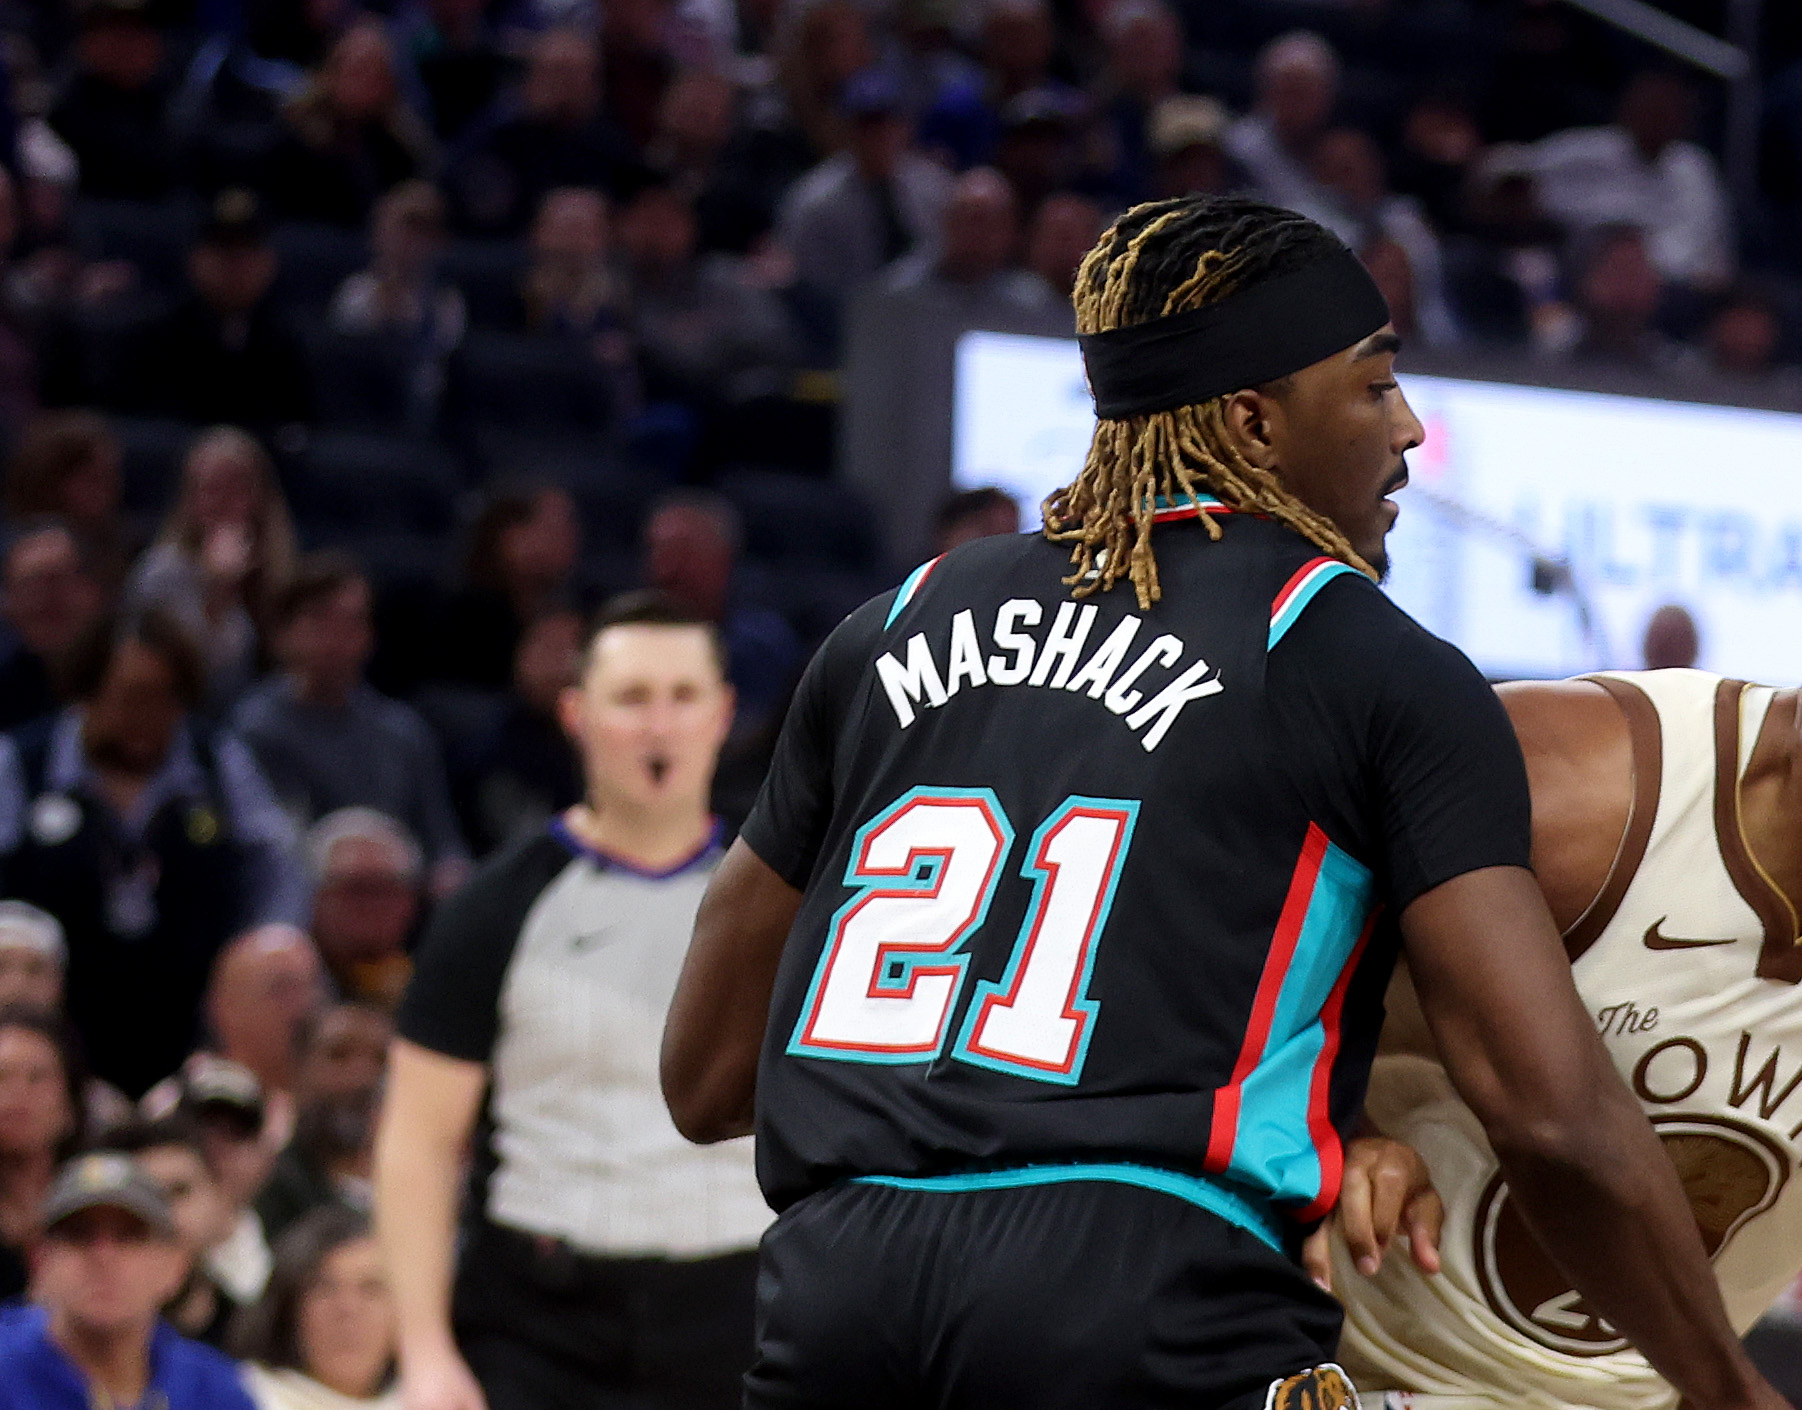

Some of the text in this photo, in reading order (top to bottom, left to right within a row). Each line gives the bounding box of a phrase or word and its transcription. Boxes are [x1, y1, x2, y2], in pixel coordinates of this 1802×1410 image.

[873, 597, 1225, 752] MASHACK
[785, 785, 1142, 1087] 21
[1597, 1000, 1660, 1037] The
